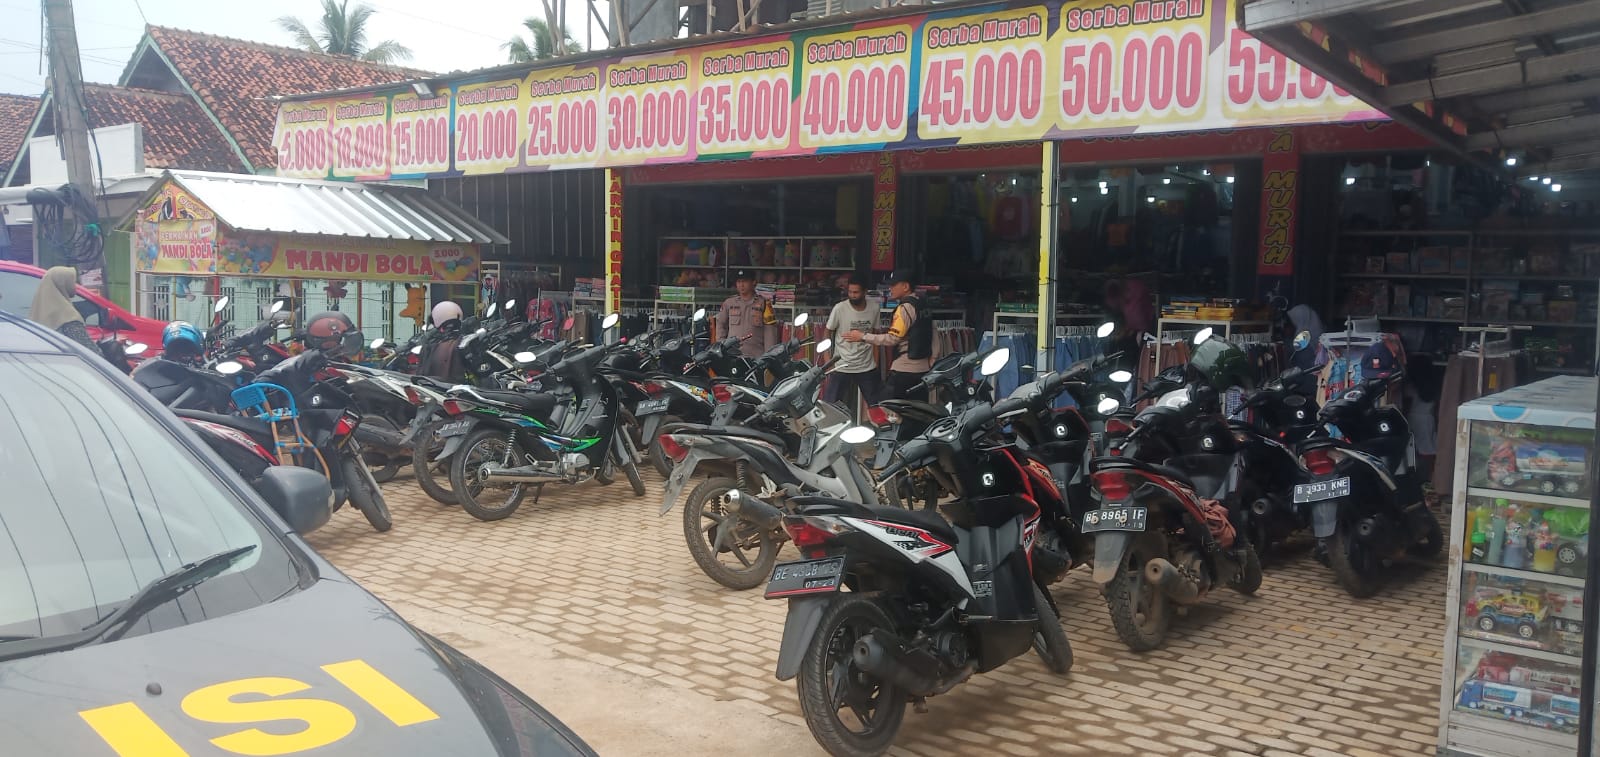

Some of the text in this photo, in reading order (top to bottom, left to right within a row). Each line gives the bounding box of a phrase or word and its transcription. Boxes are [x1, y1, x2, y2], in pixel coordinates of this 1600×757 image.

[928, 14, 1041, 49] Serba Murah
[1066, 0, 1204, 32] Serba Murah
[703, 48, 790, 76] Serba Murah
[808, 32, 906, 63] Serba Murah
[458, 83, 486, 106] Serba
[531, 74, 596, 98] Serba Murah
[609, 60, 688, 87] Serba Murah
[921, 49, 1042, 127] 45.000
[1062, 32, 1203, 117] 50.000
[608, 89, 688, 152] 30.000
[699, 77, 788, 145] 35.000
[803, 64, 906, 136] 40.000
[334, 122, 385, 169] 10.000
[393, 116, 448, 167] 15.000
[456, 107, 518, 164] 20.000
[527, 99, 597, 157] 25.000
[1263, 170, 1297, 265] MURAH
[161, 242, 213, 259] MANDI BOLA
[284, 248, 434, 276] MANDI BOLA
